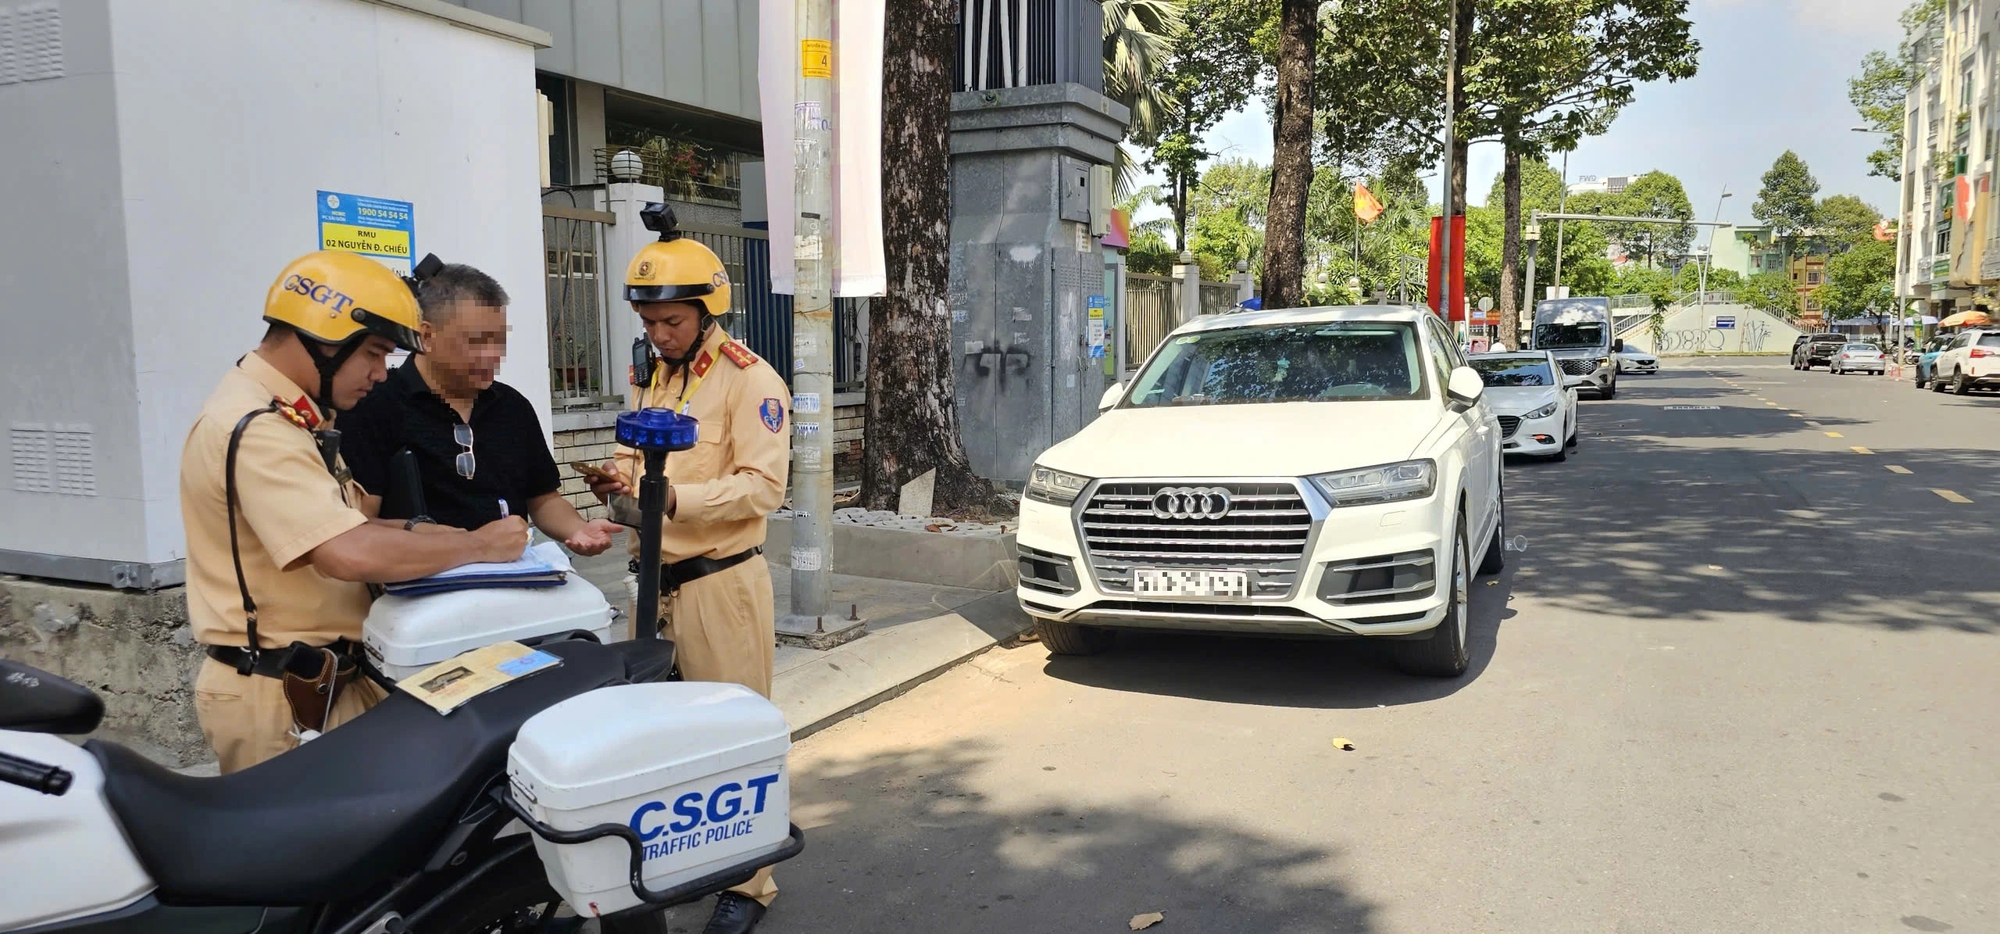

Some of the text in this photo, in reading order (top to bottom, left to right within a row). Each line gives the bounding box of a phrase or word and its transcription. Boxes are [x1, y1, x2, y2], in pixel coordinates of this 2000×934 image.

[821, 54, 828, 68] 4
[357, 207, 377, 217] 1900
[377, 209, 388, 218] 54
[388, 211, 398, 220] 54
[398, 212, 409, 221] 54
[357, 230, 377, 239] RMU
[325, 239, 337, 248] 02
[373, 243, 383, 253] Đ.
[284, 274, 354, 314] CSGT
[629, 773, 779, 843] C.S.G.T
[642, 818, 753, 862] TRAFFIC POLICE
